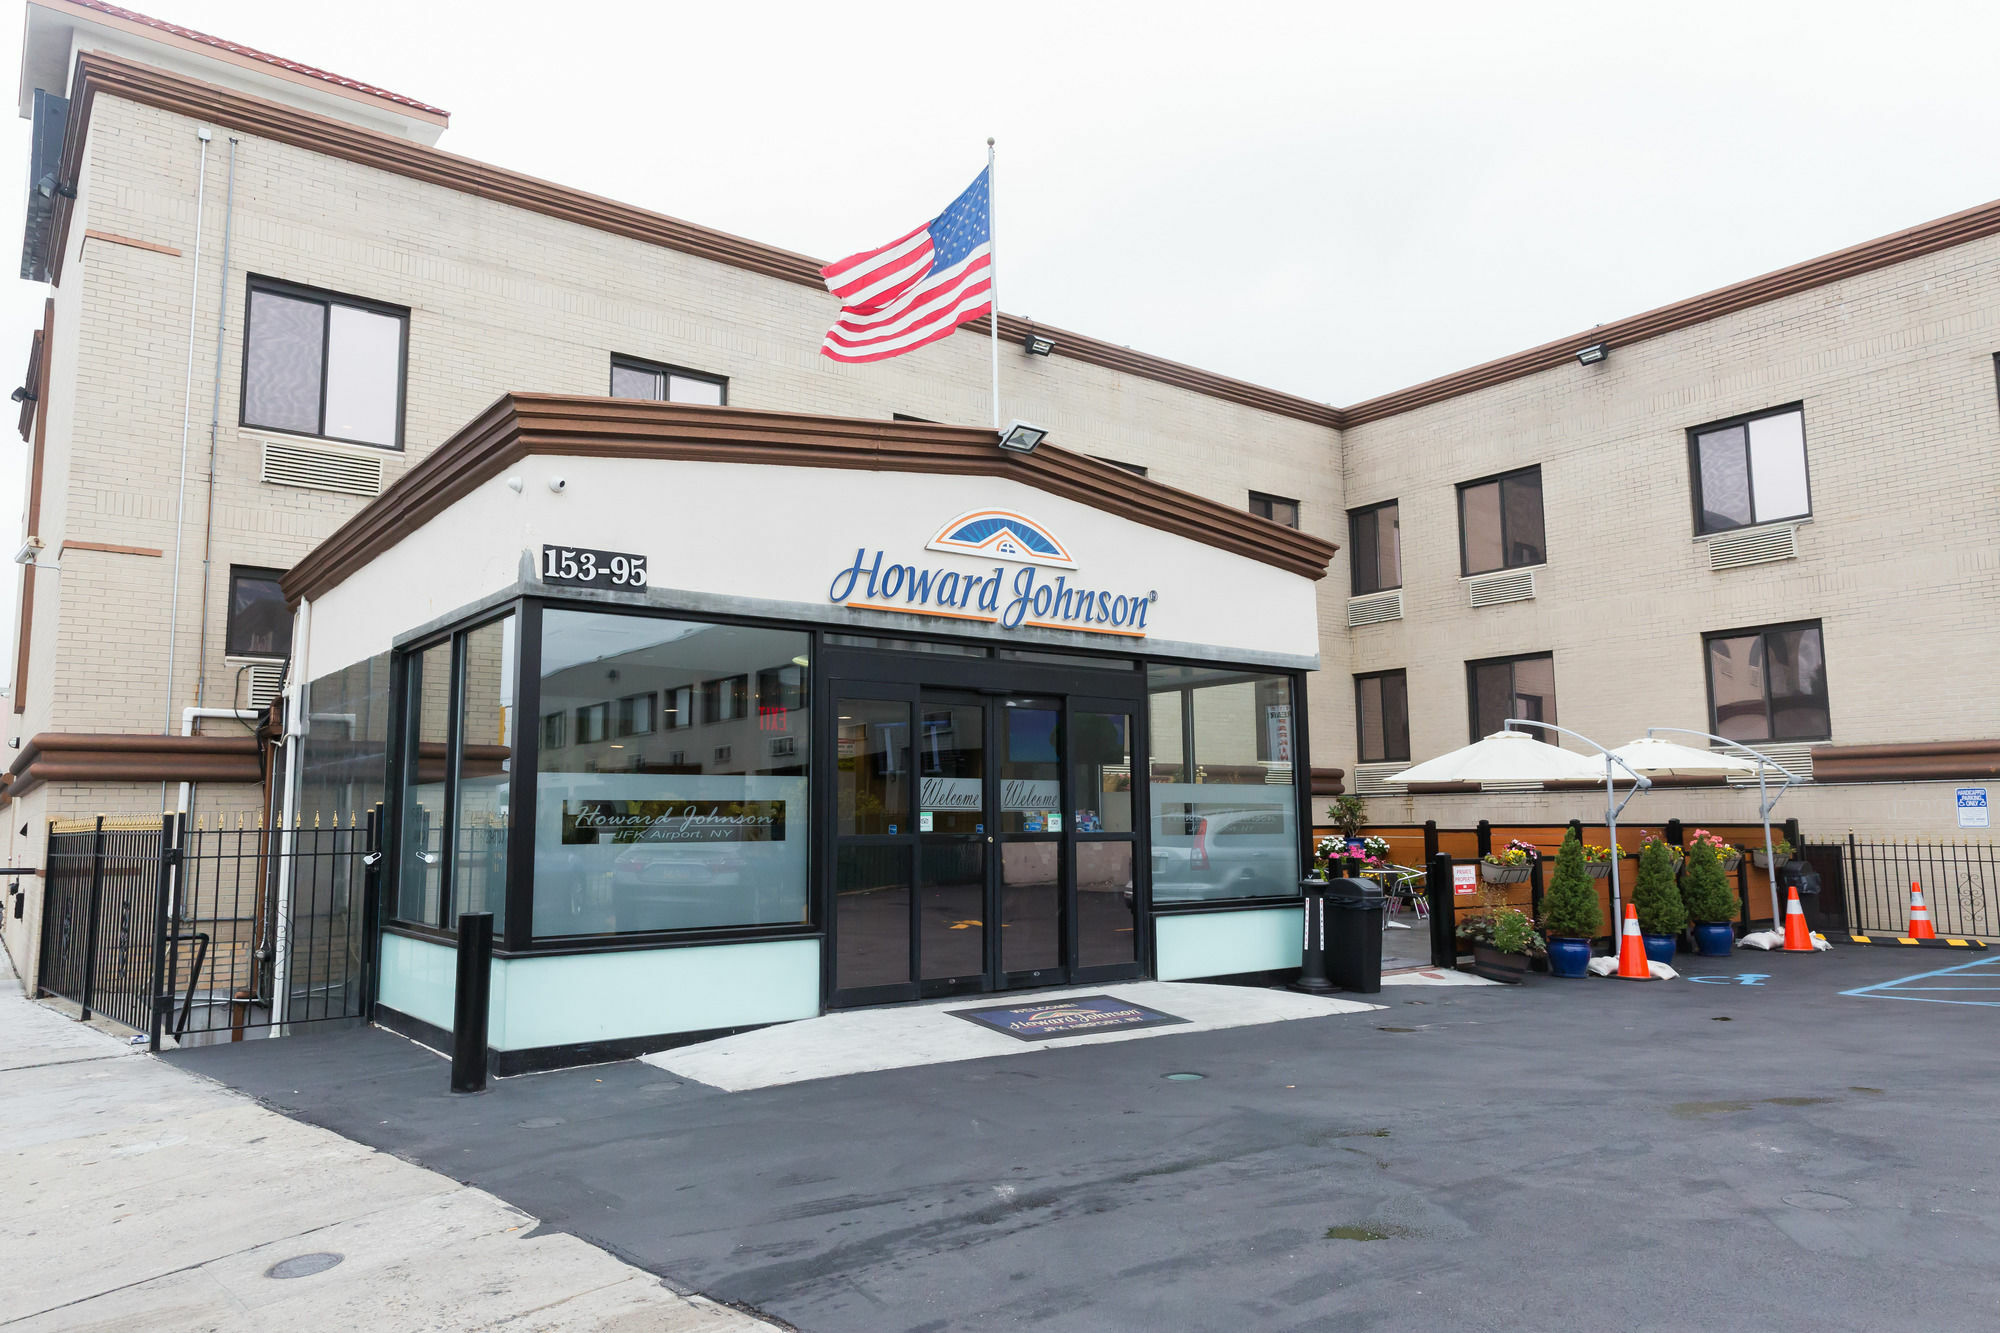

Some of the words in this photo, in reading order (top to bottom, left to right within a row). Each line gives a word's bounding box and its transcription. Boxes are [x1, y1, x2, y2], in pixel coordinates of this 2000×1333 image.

[544, 549, 647, 587] 153-95
[829, 547, 1001, 613] Howard
[921, 778, 979, 806] Welcome
[1003, 779, 1058, 807] Welcome
[575, 804, 673, 827] Howard
[680, 805, 775, 832] Johnson
[614, 830, 647, 840] JFK
[651, 829, 703, 841] Airport,
[710, 829, 734, 838] NY
[1010, 1015, 1077, 1029] Howard
[1075, 1009, 1141, 1023] Johnson
